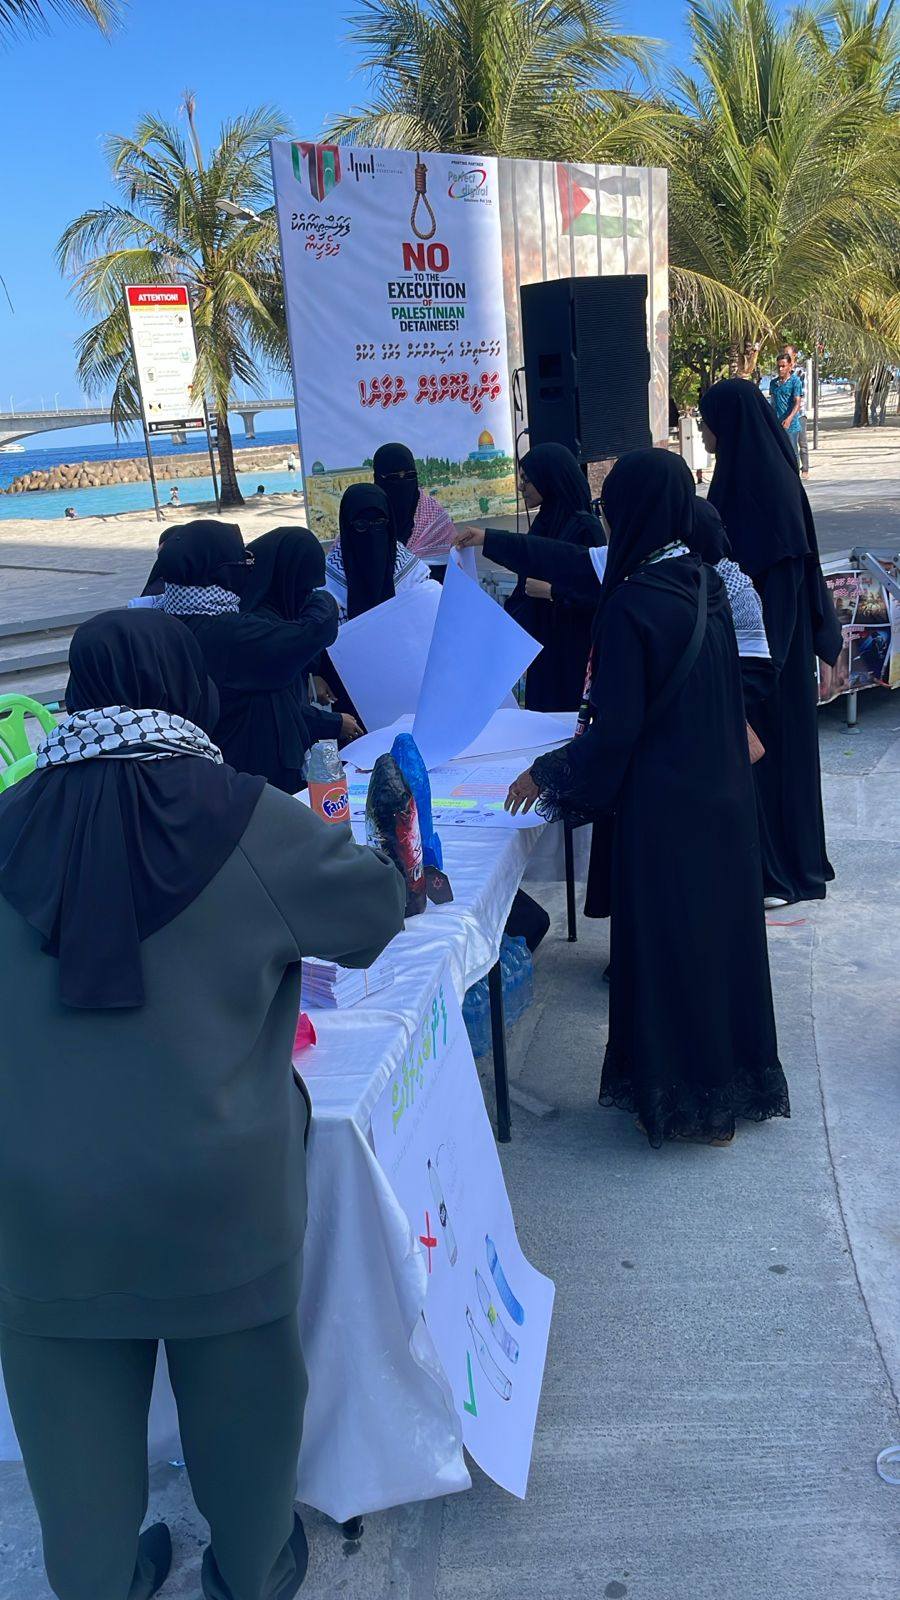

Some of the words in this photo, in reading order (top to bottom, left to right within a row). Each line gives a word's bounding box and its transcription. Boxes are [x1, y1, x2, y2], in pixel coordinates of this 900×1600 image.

[448, 170, 475, 183] Perfect
[402, 243, 449, 273] NO
[414, 273, 424, 282] TO
[426, 273, 440, 282] THE
[388, 282, 466, 299] EXECUTION
[138, 293, 179, 302] ATTENTION!
[422, 299, 432, 307] OF
[391, 306, 465, 320] PALESTINIAN
[400, 320, 459, 332] DETAINEES!
